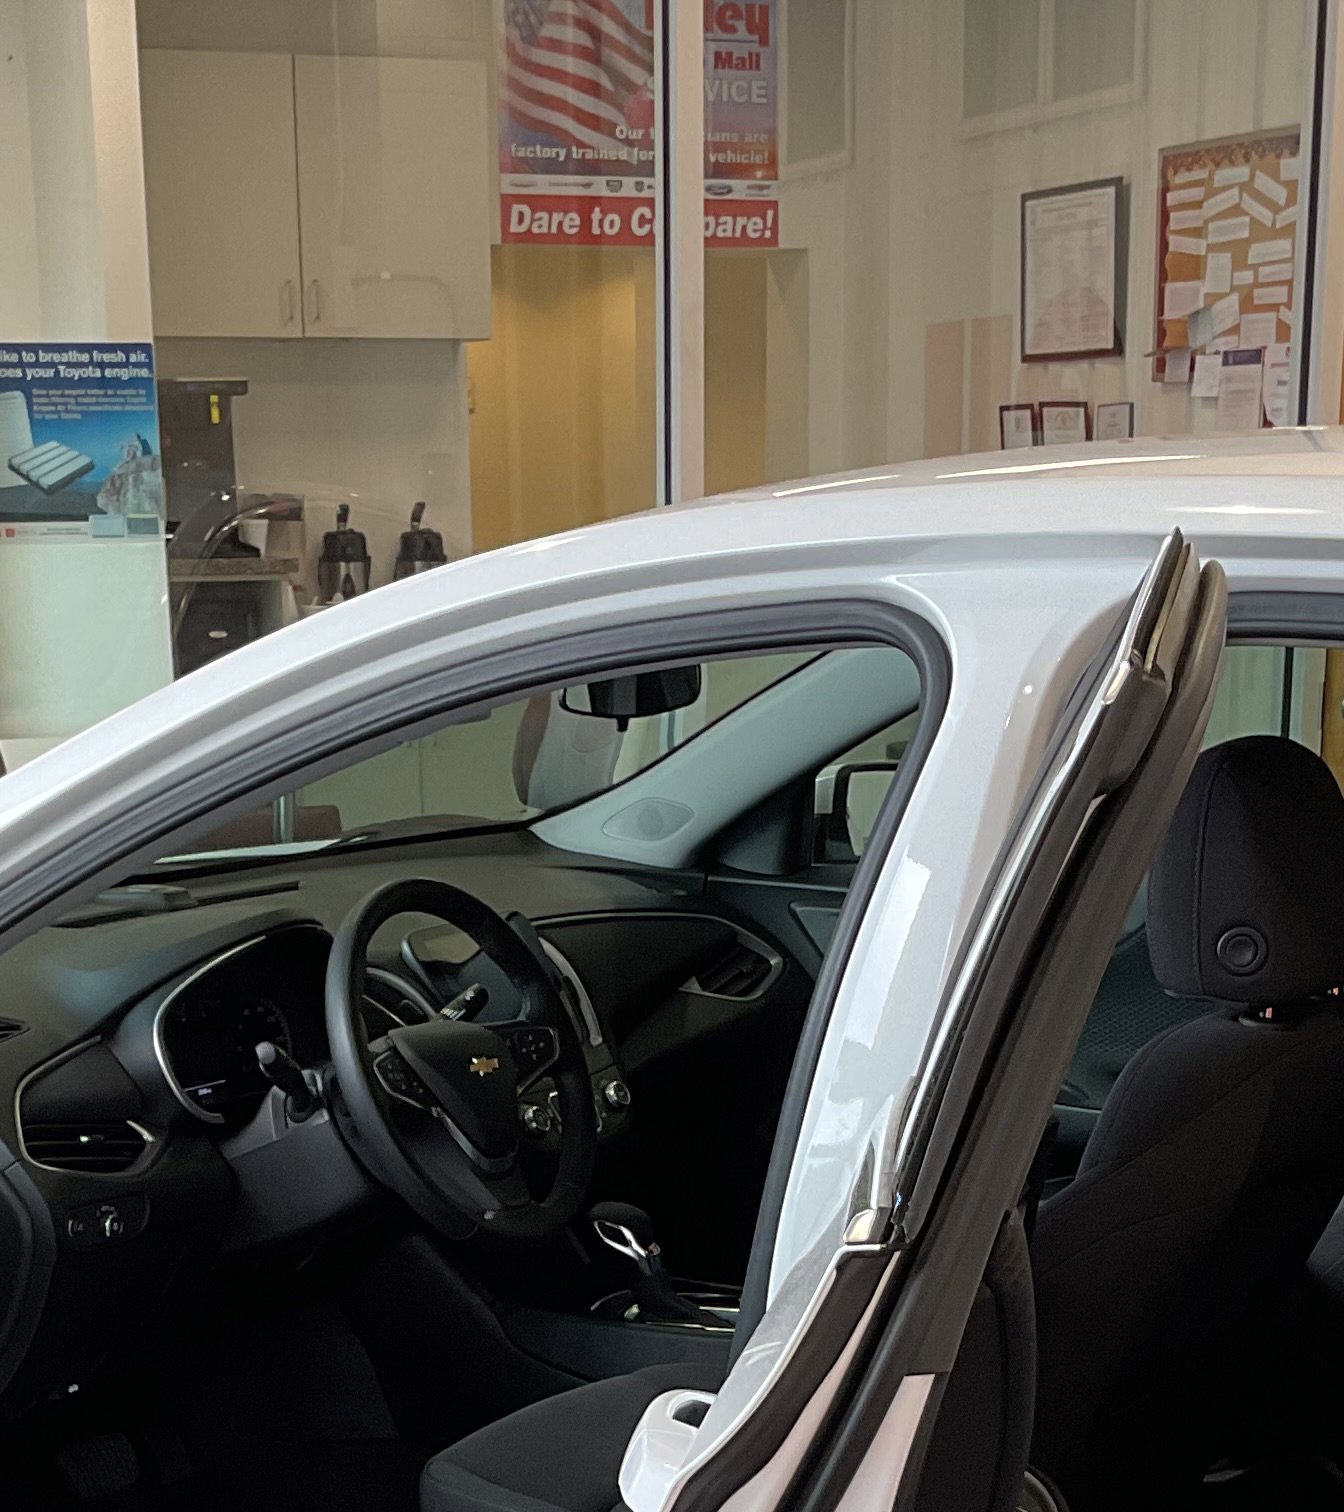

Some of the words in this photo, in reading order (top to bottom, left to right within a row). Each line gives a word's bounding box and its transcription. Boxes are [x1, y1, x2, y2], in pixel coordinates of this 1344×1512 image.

[714, 51, 760, 71] Mall
[616, 126, 644, 139] Our
[511, 144, 566, 160] factory
[571, 145, 627, 160] trained
[709, 151, 768, 164] vehicle!
[510, 204, 581, 235] Dare
[591, 207, 621, 235] to
[21, 350, 36, 362] to
[39, 350, 90, 362] breathe
[92, 350, 126, 362] fresh
[129, 350, 149, 362] air.
[25, 367, 55, 380] your
[57, 365, 101, 380] Toyota
[104, 366, 152, 380] engine.
